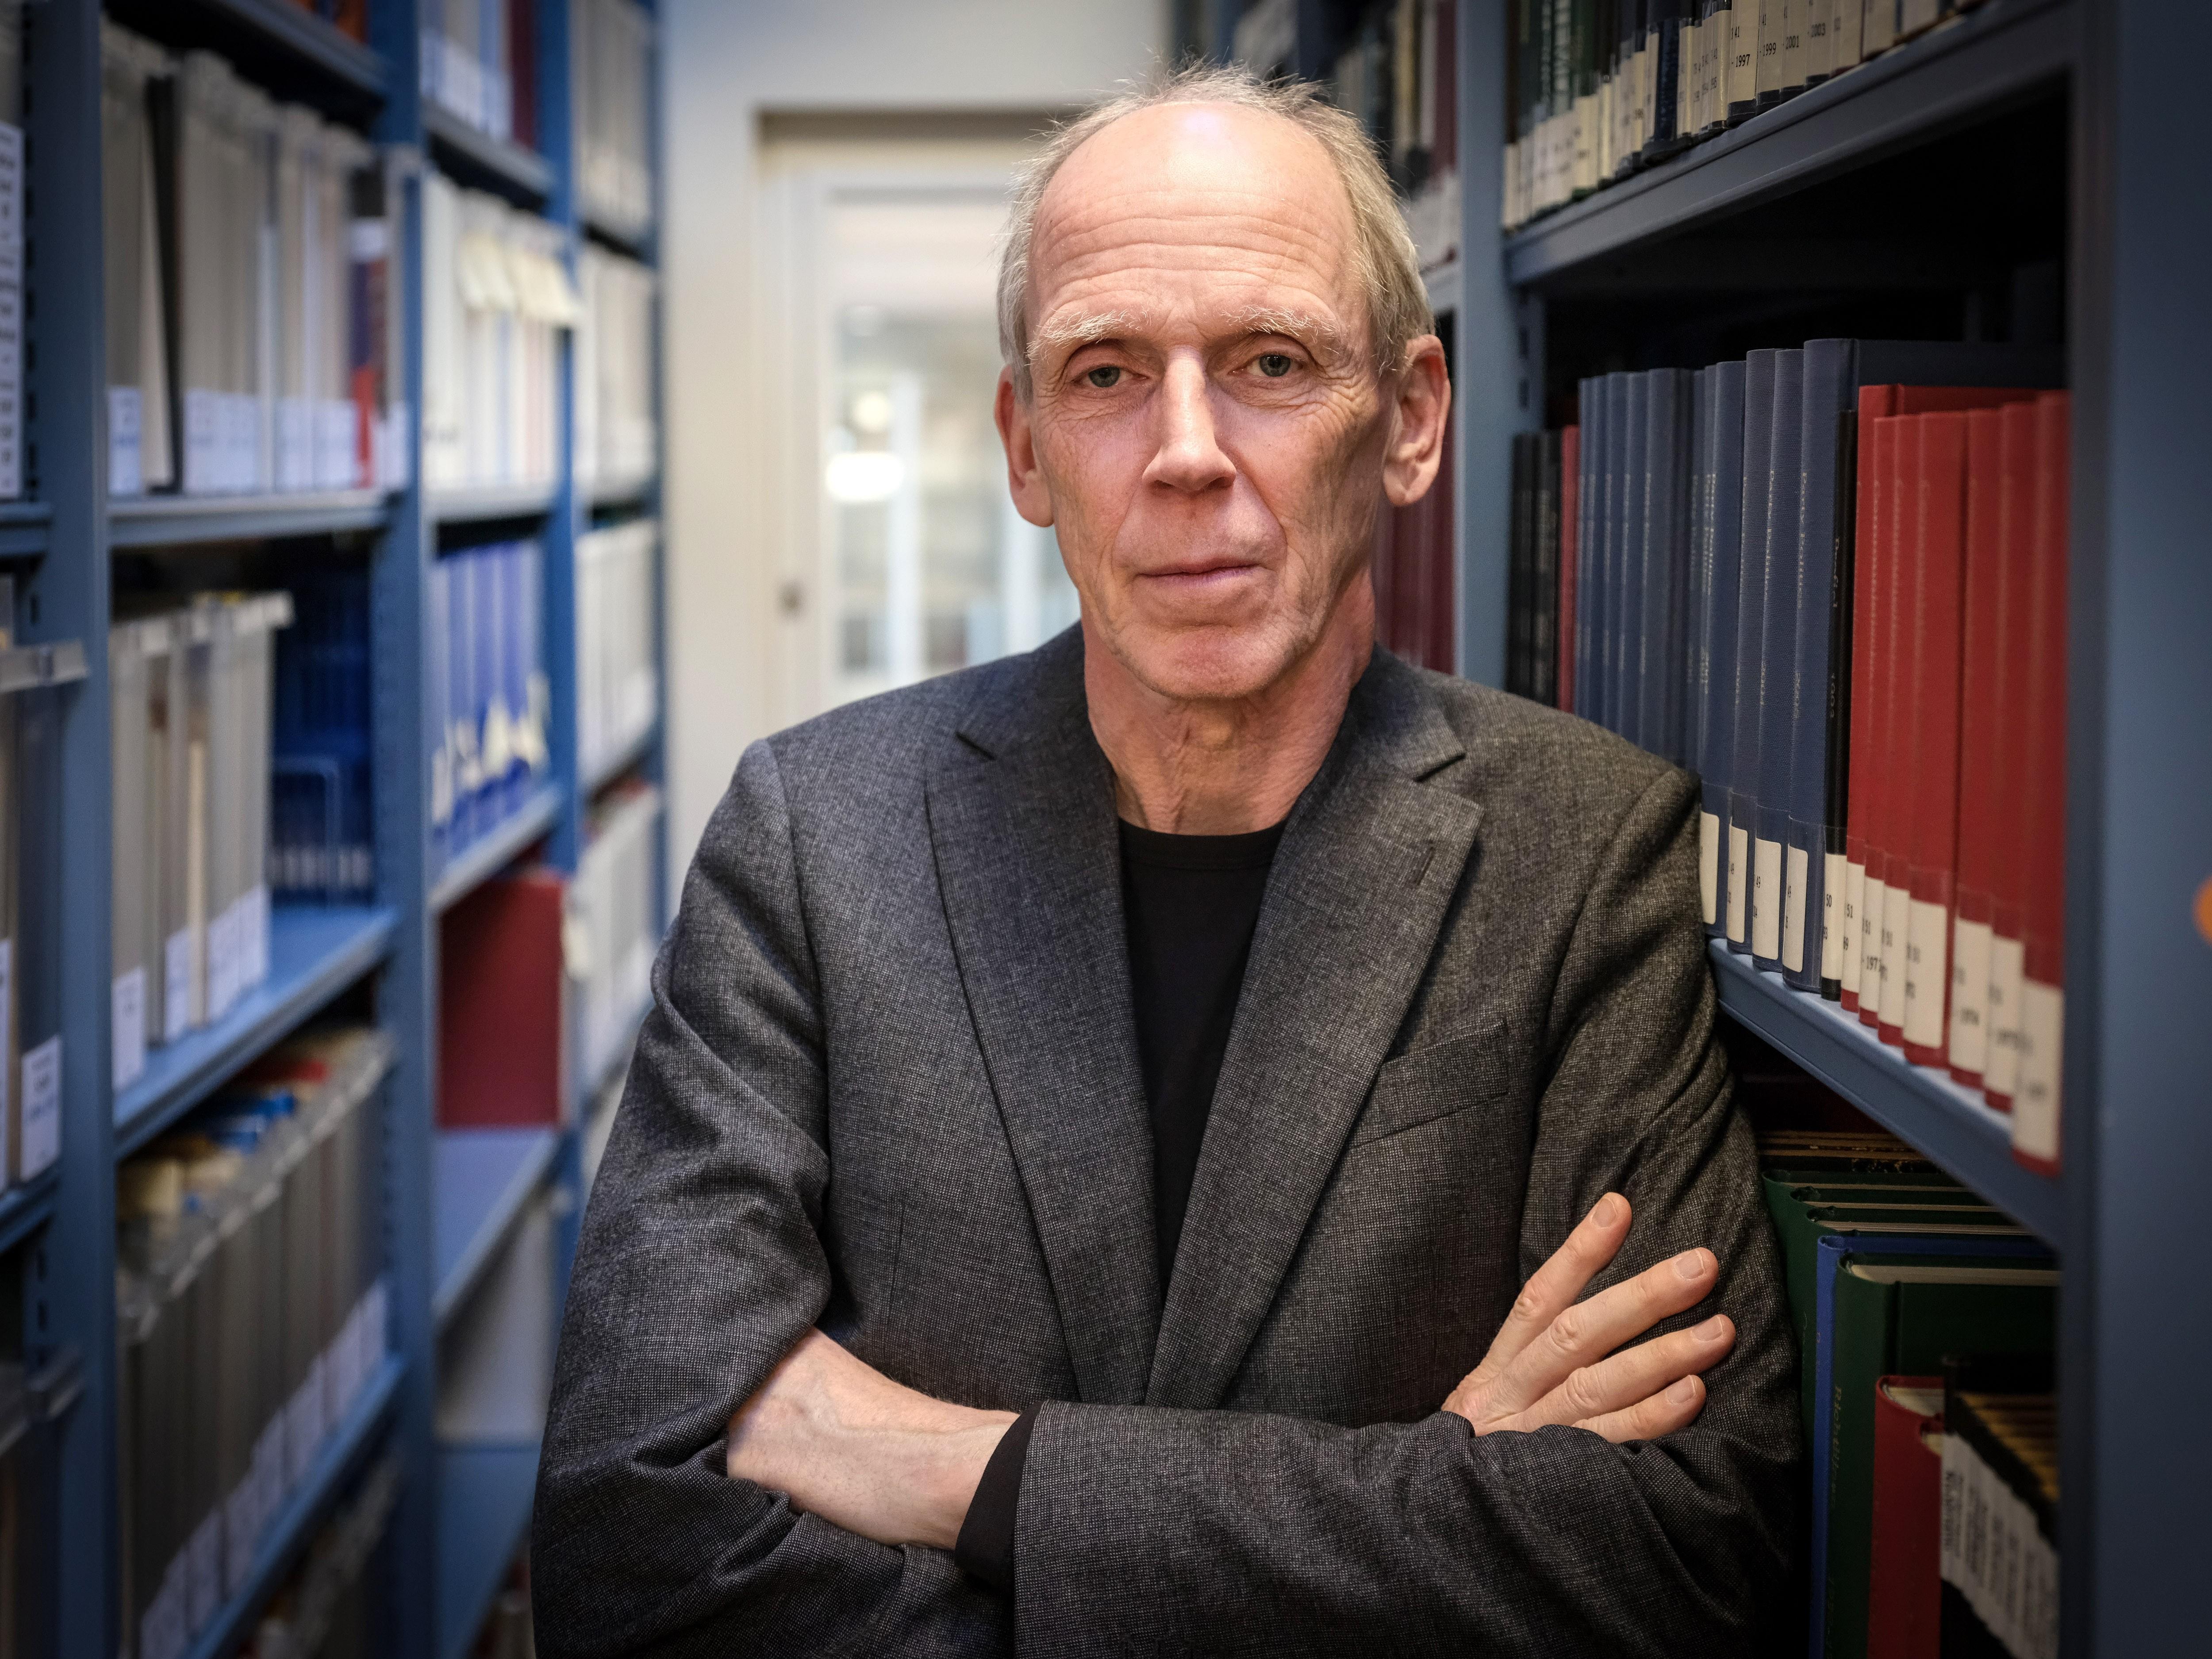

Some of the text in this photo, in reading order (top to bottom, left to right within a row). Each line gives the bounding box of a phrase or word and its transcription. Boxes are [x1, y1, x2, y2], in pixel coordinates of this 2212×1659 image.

[1735, 26, 1740, 38] 41
[1763, 42, 1777, 57] 1999
[1786, 35, 1799, 50] 2001
[1736, 54, 1751, 68] 1997
[1797, 531, 1805, 610] Politics
[1756, 875, 1761, 888] 49
[1788, 885, 1792, 898] 49
[1826, 894, 1832, 908] 50
[1847, 903, 1853, 919] 51
